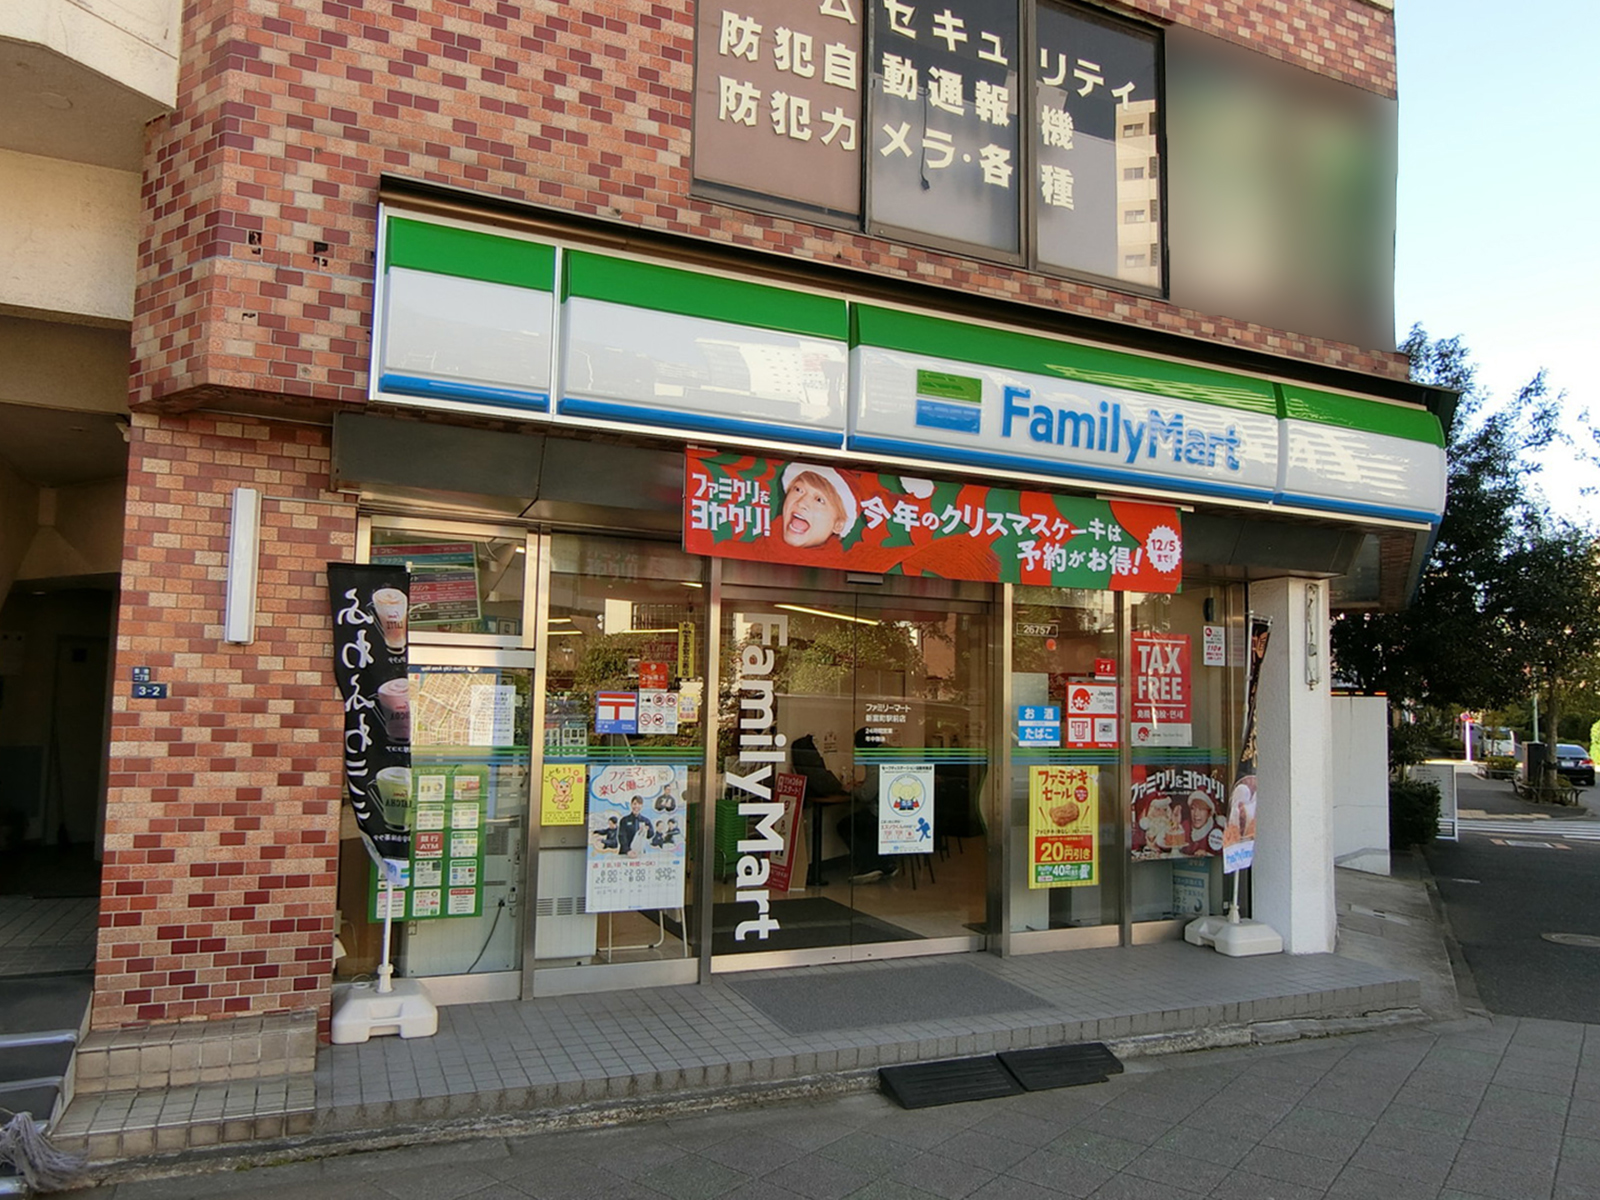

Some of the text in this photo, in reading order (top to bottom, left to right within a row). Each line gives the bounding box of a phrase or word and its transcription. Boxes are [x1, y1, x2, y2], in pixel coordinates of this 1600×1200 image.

[1001, 385, 1242, 472] FamilyMart
[692, 473, 771, 506] ファミクリを
[692, 499, 771, 537] ヨヤクリ!
[860, 496, 1122, 543] 今年のクリスマスケーキは
[1017, 540, 1142, 575] 予約がお得!
[1151, 539, 1176, 552] 12/5
[1023, 625, 1051, 634] 26757
[1138, 645, 1181, 675] TAX
[139, 686, 160, 696] 3-2
[1138, 676, 1182, 700] FREE
[865, 703, 911, 713] ファミリーマート
[1025, 727, 1054, 739] たばこ
[726, 614, 788, 942] FamilyMart
[1038, 769, 1088, 785] ファミチキ
[1042, 787, 1072, 801] セール
